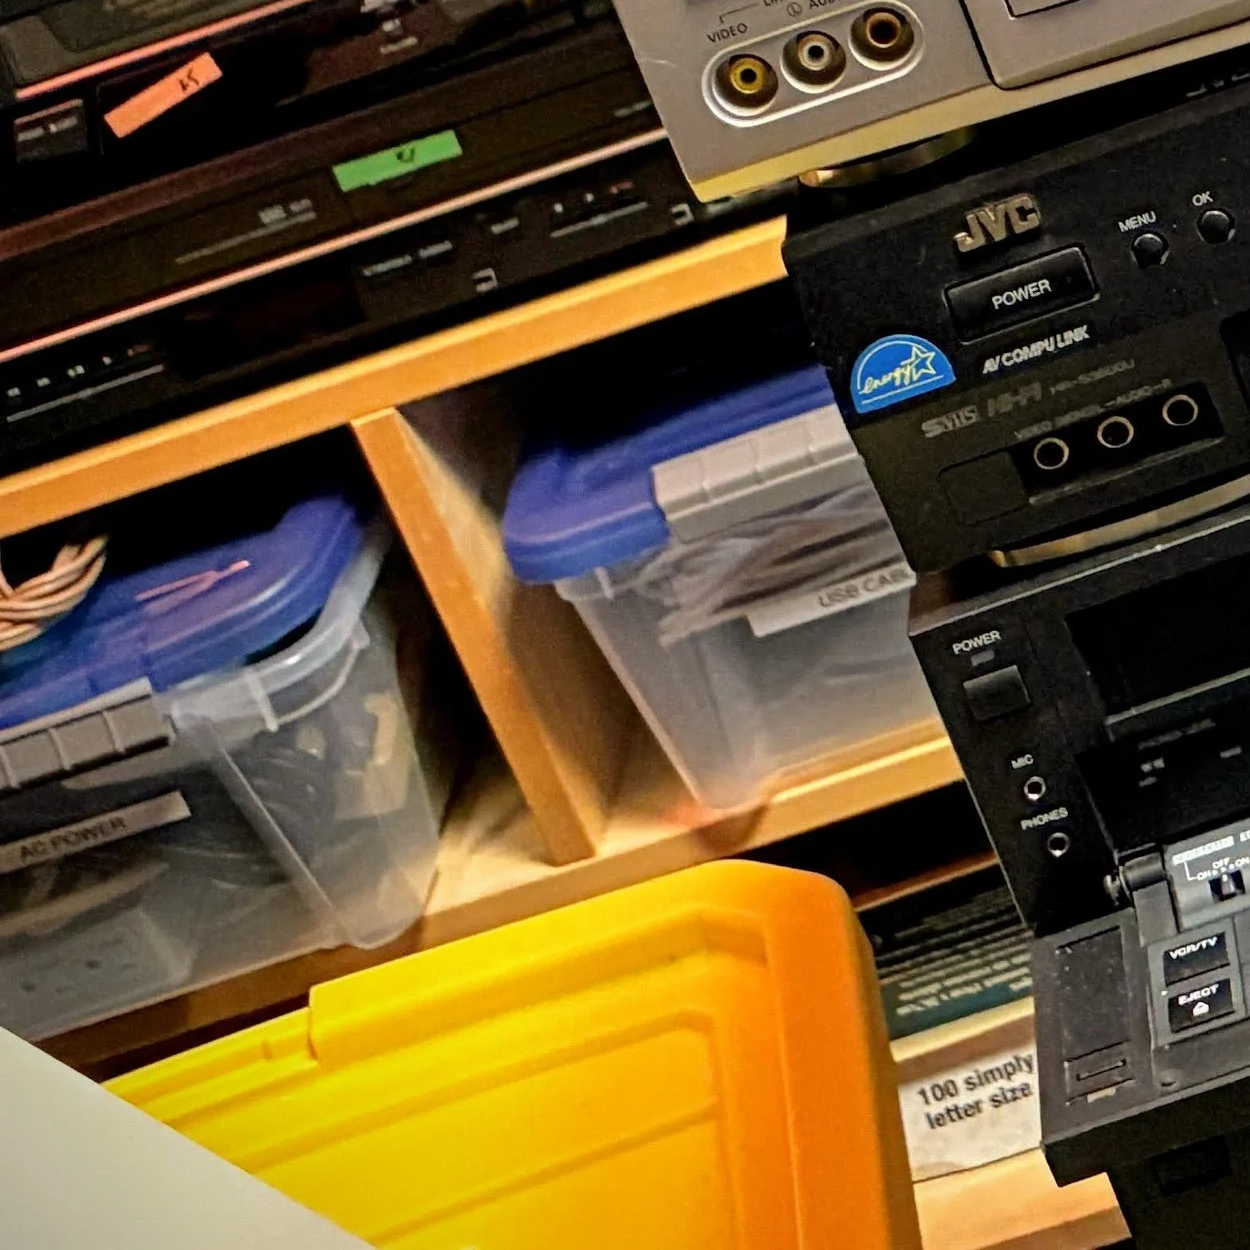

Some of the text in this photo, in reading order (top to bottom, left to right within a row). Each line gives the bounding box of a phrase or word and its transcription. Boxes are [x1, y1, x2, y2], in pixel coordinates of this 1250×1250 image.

[706, 22, 748, 44] VIDEO
[1192, 190, 1213, 207] OK
[954, 193, 1042, 252] JVC
[1118, 210, 1157, 233] MENU
[991, 278, 1053, 309] POWER
[1056, 325, 1091, 349] LINK
[860, 361, 917, 396] energy
[952, 629, 1001, 655] POWER
[1021, 806, 1069, 831] PHONES
[1178, 983, 1219, 1006] EJECT
[917, 1054, 1035, 1106] 100 simply
[925, 1082, 1033, 1130] letter size
